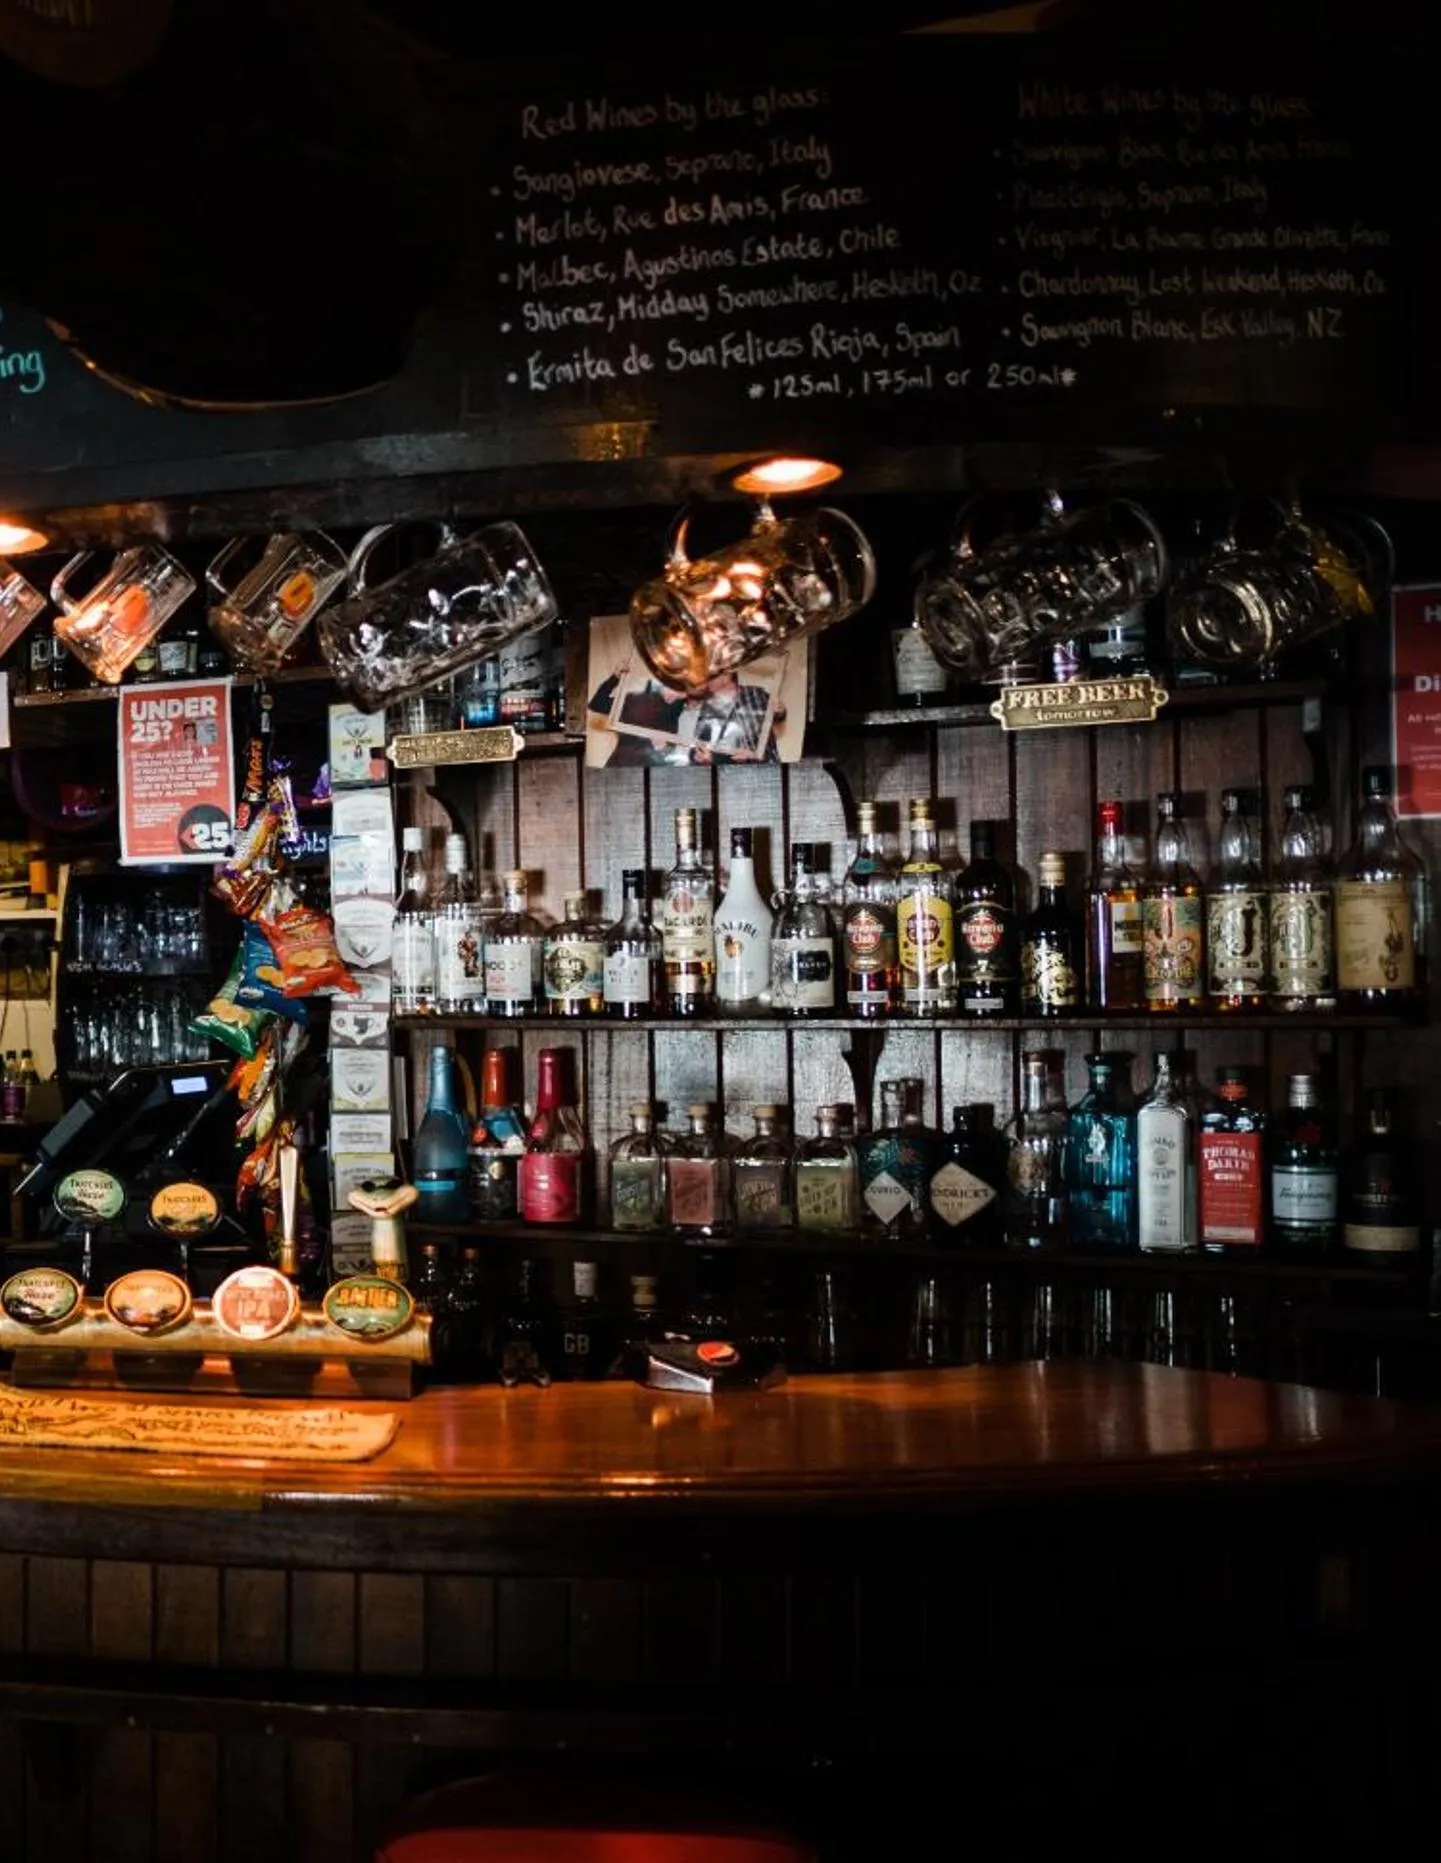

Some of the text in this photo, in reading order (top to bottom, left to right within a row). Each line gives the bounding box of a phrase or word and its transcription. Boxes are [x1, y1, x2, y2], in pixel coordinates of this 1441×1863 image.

[521, 103, 577, 140] Red
[585, 94, 658, 131] Wines
[664, 91, 699, 131] by
[704, 90, 747, 121] the
[1171, 82, 1201, 133] by
[768, 133, 832, 180] Italy
[514, 211, 608, 246] Merlot,
[611, 203, 657, 235] Rue
[663, 195, 705, 227] des
[780, 183, 868, 214] France
[516, 222, 902, 292] Malbec, Agustinos Estate, Chile
[521, 300, 615, 333] Shiraz,
[616, 290, 710, 322] Midday
[716, 275, 848, 313] Somewhere,
[948, 269, 983, 294] Oz
[1305, 307, 1344, 339] NZ
[526, 322, 962, 391] Ermita de San Felices Rioja, Spain
[861, 369, 933, 395] 175ml
[943, 367, 972, 388] or
[129, 696, 219, 721] UNDER
[1007, 681, 1147, 710] FREE BEER
[1035, 706, 1118, 722] tomorrow
[130, 720, 174, 744] 25?
[191, 821, 230, 850] 25
[236, 1299, 273, 1320] IPA
[563, 1332, 591, 1355] GB
